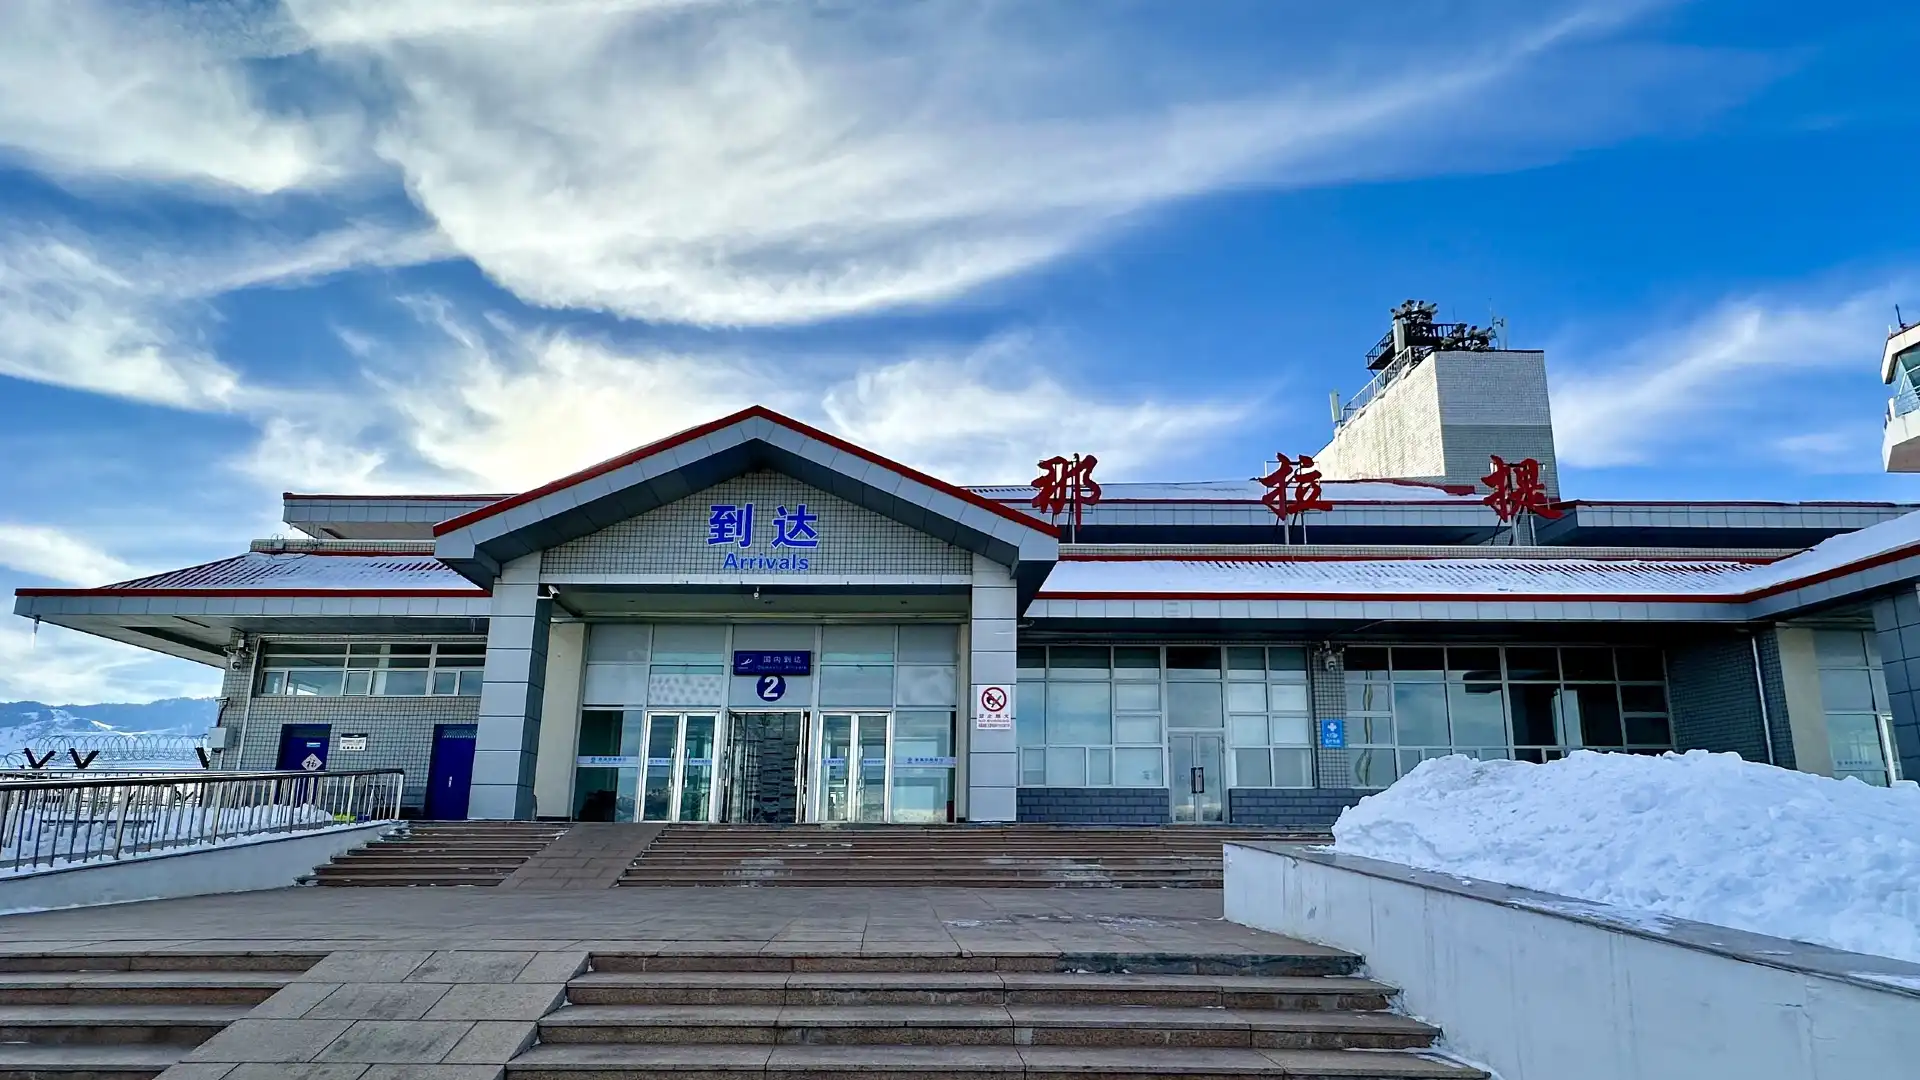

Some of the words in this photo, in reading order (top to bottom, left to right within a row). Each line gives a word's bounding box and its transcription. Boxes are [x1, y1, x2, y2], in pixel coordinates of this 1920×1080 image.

[1031, 453, 1563, 531] 那拉提
[706, 503, 820, 549] 到达
[723, 552, 809, 571] Arrivals
[763, 676, 778, 698] 2
